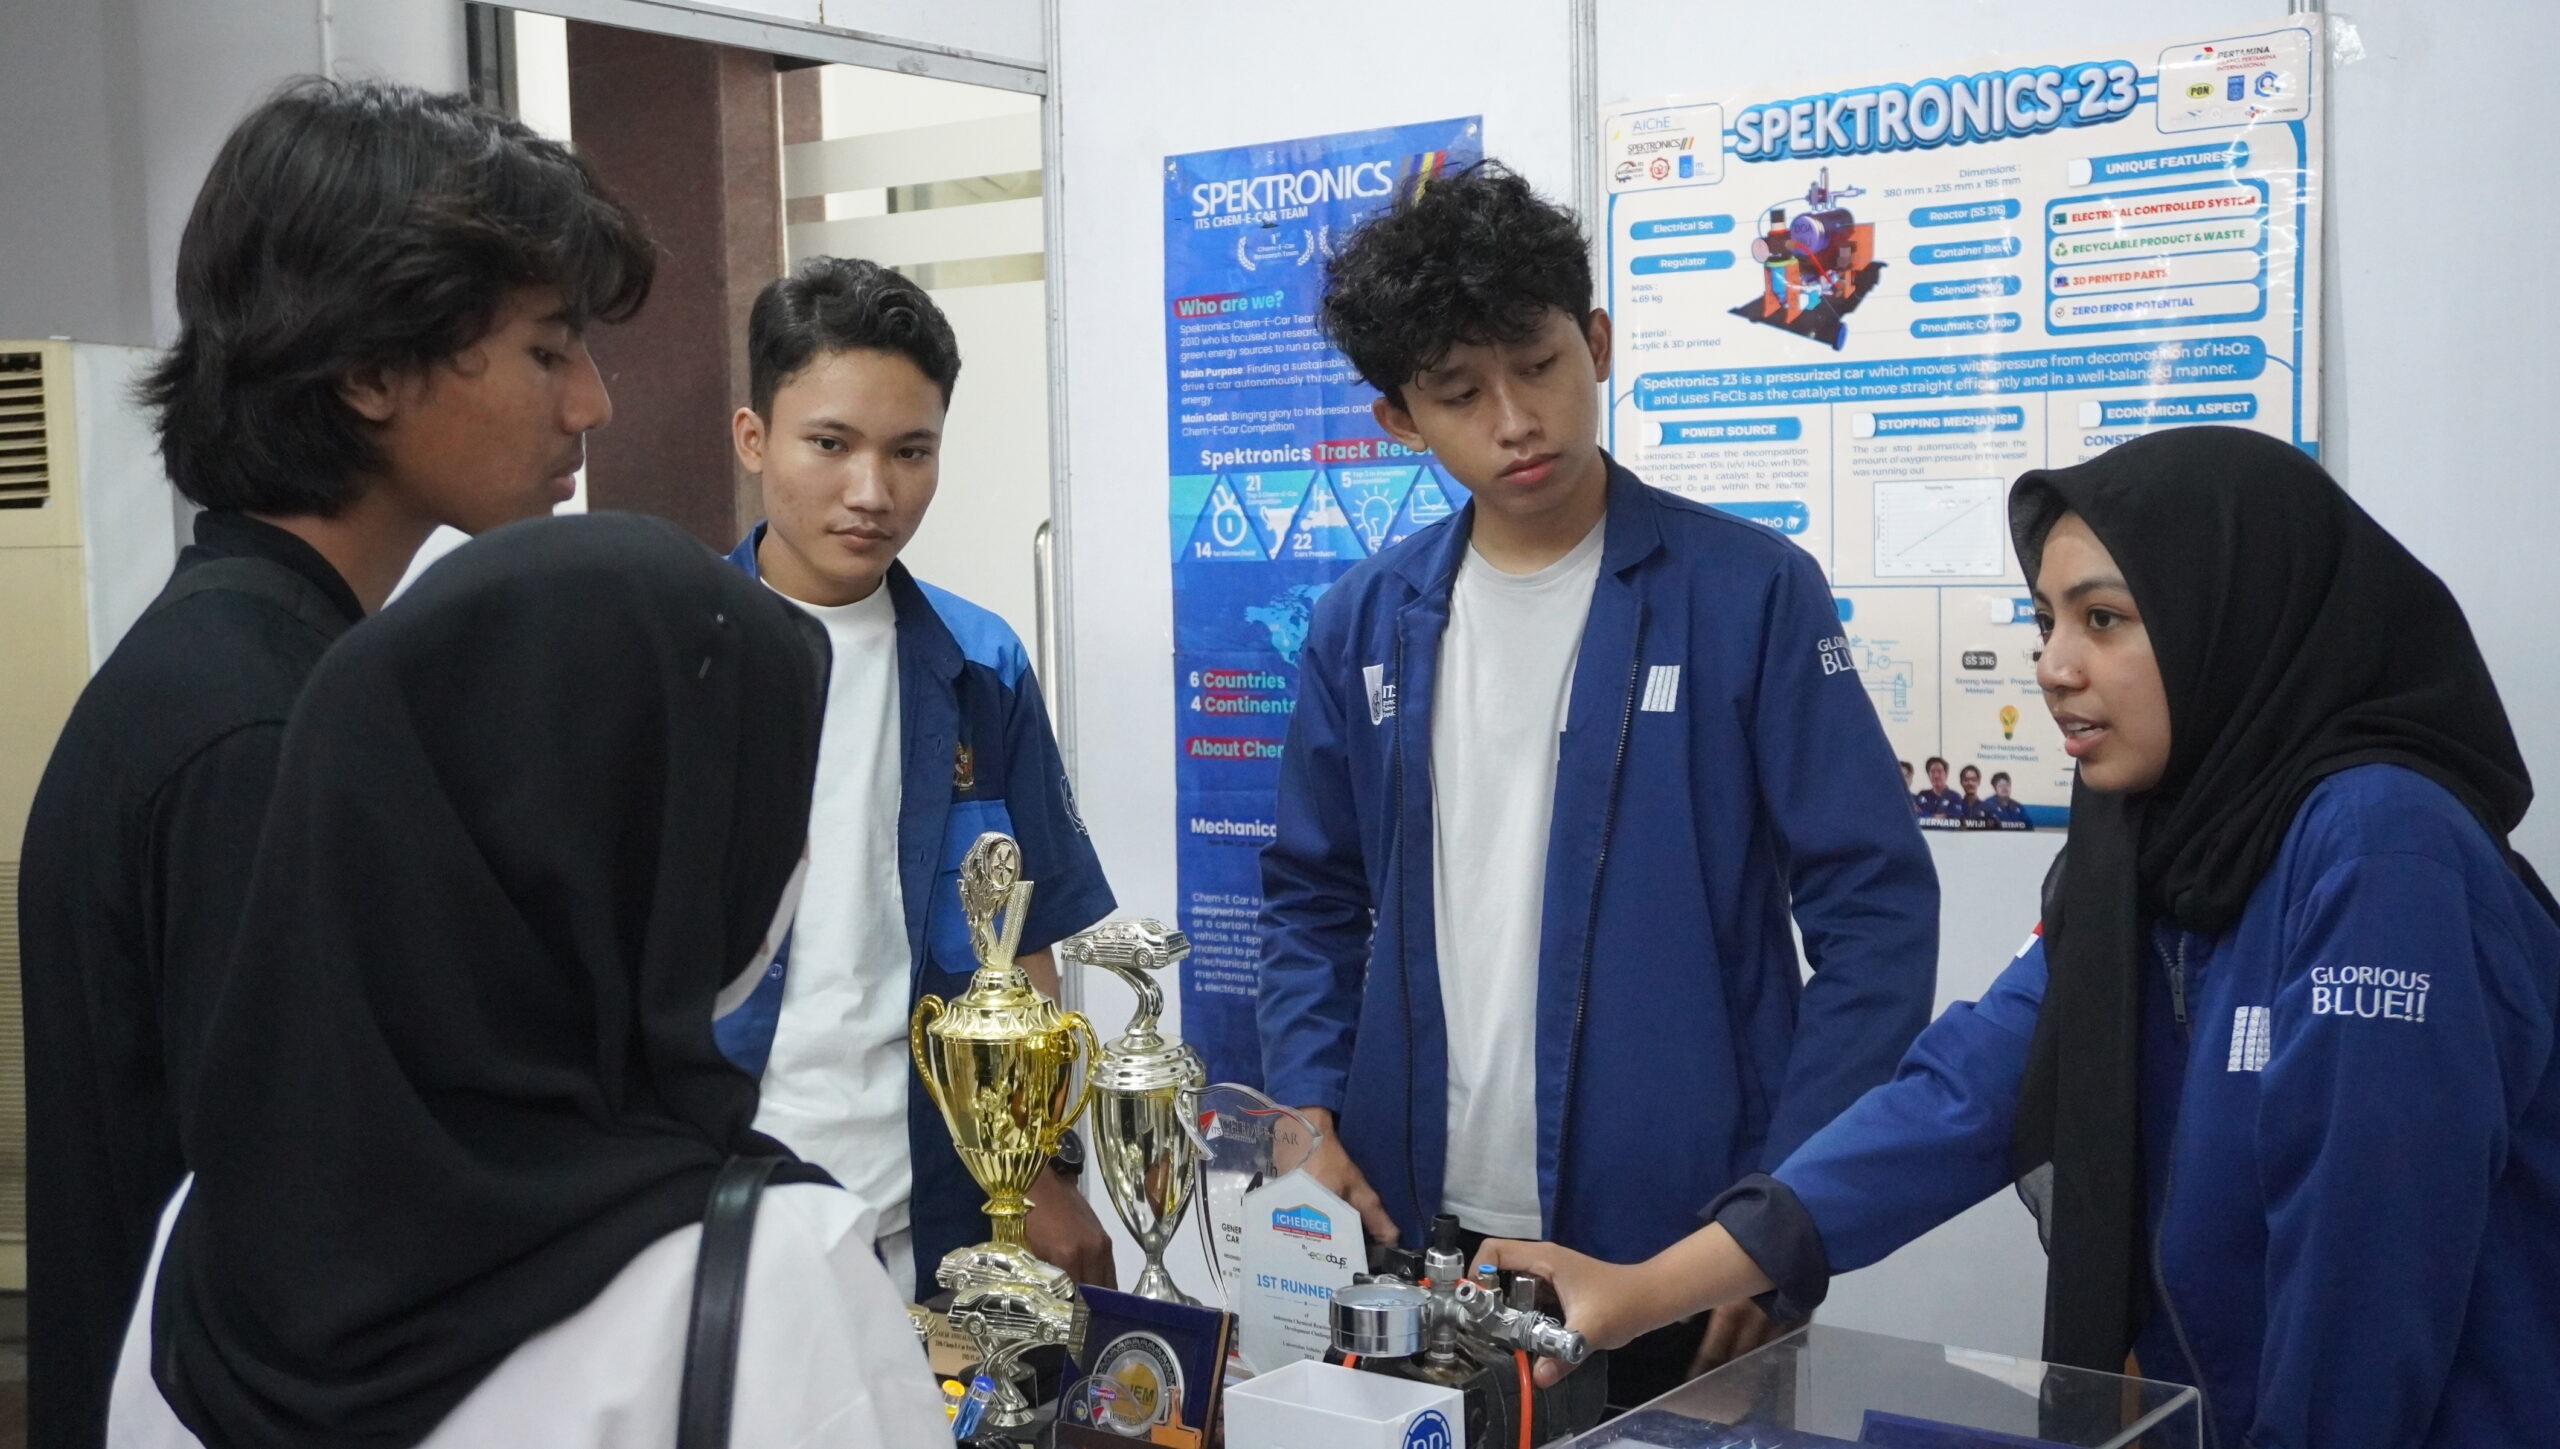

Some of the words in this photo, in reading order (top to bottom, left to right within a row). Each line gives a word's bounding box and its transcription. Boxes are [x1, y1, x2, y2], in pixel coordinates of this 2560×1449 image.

[2190, 85, 2210, 97] PON
[1735, 64, 2139, 155] SPEKTRONICS-23
[1627, 139, 1681, 153] SPEKTRONICS
[1960, 165, 2016, 178] Dimensions
[2106, 157, 2158, 175] UNIQUE
[2160, 151, 2233, 169] FEATURES
[1192, 161, 1394, 217] SPEKTRONICS
[1883, 188, 1902, 198] 380
[1905, 187, 1924, 196] mm
[1935, 184, 1952, 193] 235
[1955, 182, 1974, 191] mm
[1985, 179, 1999, 188] 195
[2002, 177, 2021, 186] mm
[1930, 210, 1968, 221] Reactor
[1970, 207, 1986, 219] (SS
[2135, 200, 2206, 216] CONTROLLED
[1195, 218, 1210, 230] ITS
[1213, 211, 1277, 228] CHEM-E-CAR
[1280, 207, 1308, 221] TEAM
[1653, 221, 1697, 234] Electrical
[1698, 220, 1714, 231] Set
[2073, 239, 2138, 254] RECYCLABLE
[2140, 234, 2192, 248] PRODUCT
[2194, 232, 2203, 242] &
[2204, 229, 2245, 242] WASTE
[1933, 245, 1981, 258] Container
[1660, 256, 1707, 270] Regulator
[2073, 275, 2087, 286] 3D
[2088, 272, 2132, 285] PRINTED
[2134, 269, 2168, 281] PARTS
[1933, 283, 1976, 296] Solenoid
[1178, 298, 1217, 316] Who
[1220, 298, 1248, 313] are
[1251, 290, 1284, 309] we?
[2072, 305, 2099, 316] ZERO
[2100, 302, 2134, 314] ERROR
[2136, 298, 2195, 310] POTENTIAL
[1180, 321, 1231, 335] Spektronics
[1233, 316, 1291, 329] Chem-E-Car
[1921, 320, 1974, 333] Pneumatic
[1180, 337, 1200, 347] 2010
[1201, 335, 1220, 345] who
[1222, 335, 1229, 343] is
[1231, 330, 1267, 343] focused
[1269, 331, 1281, 340] on
[1687, 337, 1721, 349] printed
[1180, 351, 1206, 363] green
[1208, 348, 1238, 361] energy
[1239, 345, 1274, 356] sources
[1275, 343, 1285, 353] to
[1286, 343, 1301, 352] run
[1180, 369, 1204, 379] Main
[1247, 362, 1280, 375] Finding
[1291, 358, 1346, 371] sustainable
[1643, 374, 1719, 391] Spektronics
[1723, 374, 1738, 385] 23
[1741, 373, 1751, 384] is
[1754, 375, 1762, 384] a
[1766, 369, 1840, 386] pressurized
[1844, 369, 1864, 379] car
[1869, 364, 1909, 377] which
[1913, 363, 1957, 375] moves
[1993, 357, 2048, 373] pressure
[2051, 355, 2084, 367] from
[2087, 346, 2190, 366] decomposition
[2194, 343, 2209, 357] of
[1181, 382, 1205, 392] drive
[1216, 381, 1232, 390] car
[1235, 375, 1303, 389] autonomously
[1306, 371, 1344, 384] through
[1654, 392, 1678, 405] and
[1681, 393, 1709, 404] uses
[1750, 391, 1764, 400] as
[1767, 387, 1789, 400] the
[1792, 385, 1841, 400] catalyst
[1844, 386, 1857, 396] to
[1861, 384, 1898, 395] move
[1901, 381, 1952, 396] straight
[1956, 375, 2021, 391] efficntly
[2023, 372, 2048, 386] and
[2051, 372, 2063, 384] in
[2066, 374, 2074, 383] a
[2078, 366, 2172, 382] well-balanced
[2175, 366, 2237, 377] manner.
[1182, 413, 1204, 423] Main
[1231, 409, 1267, 422] Bringing
[1269, 407, 1292, 420] glory
[1294, 407, 1303, 416] to
[1306, 404, 1350, 416] Indonesia
[1352, 403, 1372, 413] and
[2106, 404, 2193, 419] ECONOMICAL
[2196, 401, 2250, 415] ASPECT
[1182, 426, 1239, 437] Chem-E-Car
[1240, 422, 1295, 435] Competition
[1879, 416, 1940, 430] STOPPING
[1943, 413, 2018, 427] MECHANISM
[1681, 426, 1724, 438] POWER
[1727, 424, 1776, 436] SOURCE
[1201, 444, 1312, 470] Spektronics
[1317, 441, 1370, 460] Track
[1376, 441, 1433, 458] Rec
[1853, 446, 1868, 454] The
[1893, 444, 1912, 455] stop
[1917, 441, 1978, 452] automatically
[2012, 439, 2027, 448] the
[1852, 456, 1888, 465] amount
[1890, 455, 1899, 464] of
[1900, 455, 1933, 465] oxygen
[1935, 453, 1973, 463] pressure
[1342, 471, 1352, 488] 5
[1852, 469, 1870, 477] was
[1872, 466, 1907, 477] running
[1909, 466, 1925, 475] out
[1246, 475, 1261, 492] 21
[1194, 541, 1212, 558] 14
[1292, 533, 1312, 550] 22
[1965, 656, 1977, 666] SS
[1979, 656, 1995, 666] 316
[1189, 671, 1200, 688] 6
[1203, 671, 1286, 689] Countries
[1191, 696, 1201, 712] 4
[1204, 695, 1296, 713] Continents
[1191, 739, 1240, 757] About
[1919, 817, 1961, 828] BERNARD
[1966, 819, 1986, 828] WIJI
[2311, 966, 2431, 991] GLORIOUS
[2312, 986, 2427, 1023] BLUE!!
[1221, 1223, 1242, 1234] GENER
[1276, 1213, 1329, 1232] ICHEDECE
[1257, 1274, 1278, 1289] 1ST
[1280, 1278, 1334, 1299] RUNNER
